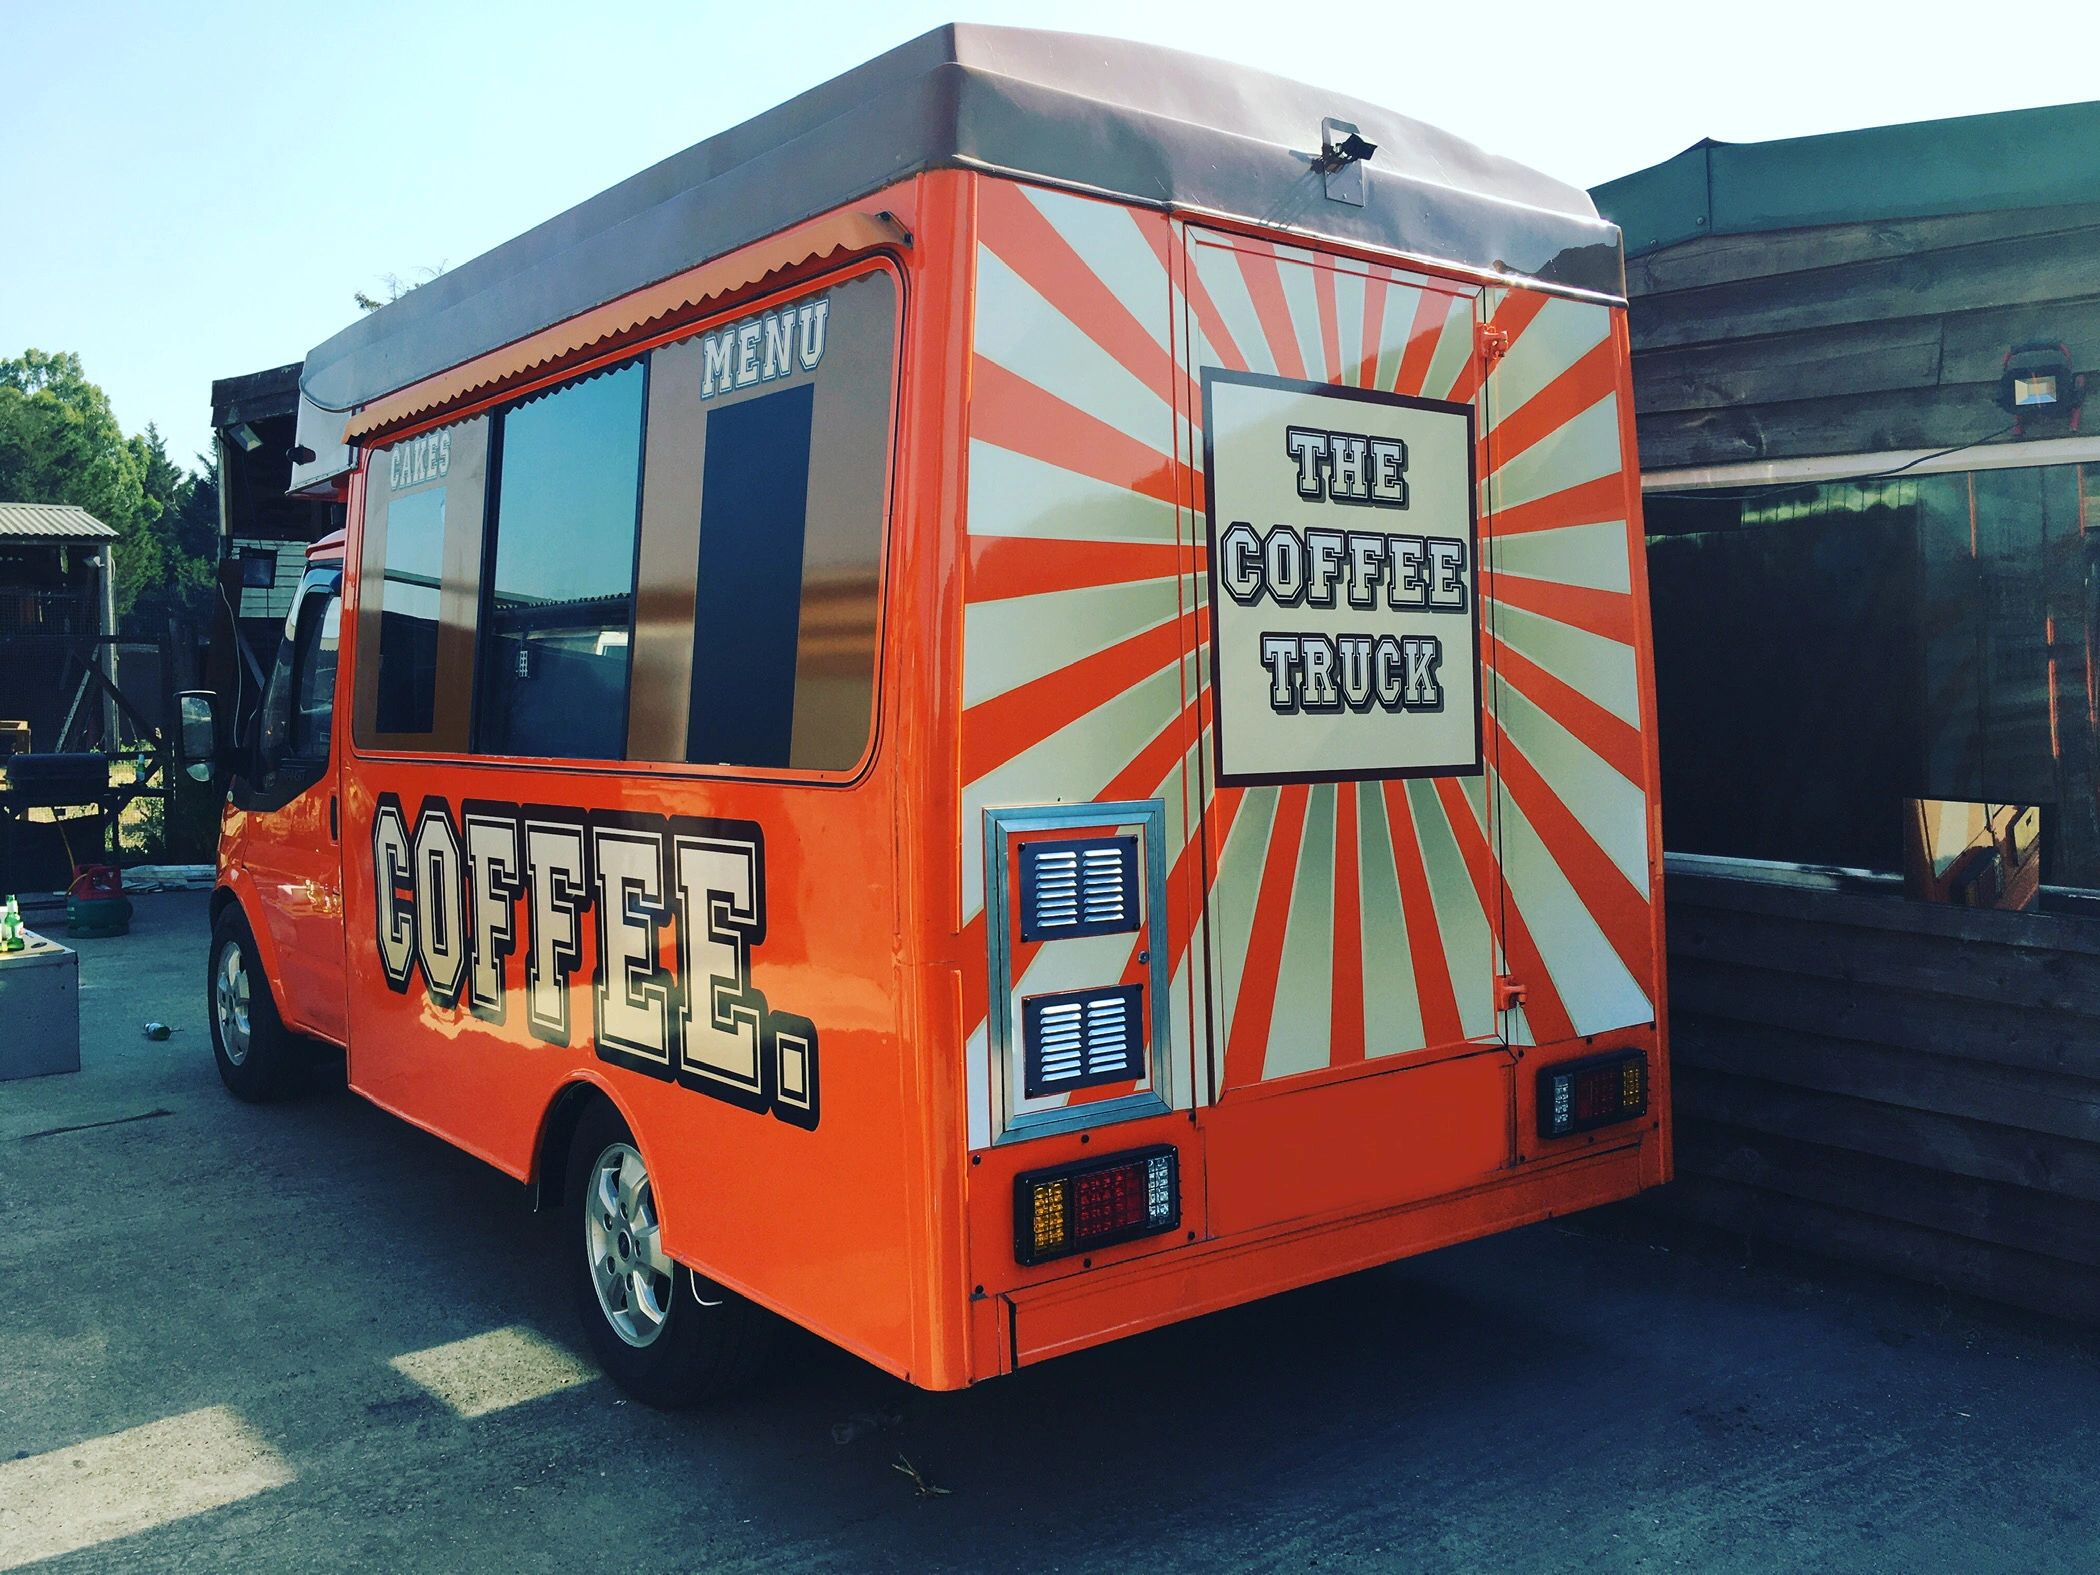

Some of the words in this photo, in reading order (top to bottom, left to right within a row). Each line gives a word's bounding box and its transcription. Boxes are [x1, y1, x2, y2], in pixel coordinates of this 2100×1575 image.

[702, 299, 829, 399] MENU
[390, 429, 452, 491] CAKES
[1286, 425, 1409, 510] THE
[1220, 521, 1468, 614] COFFEE
[1260, 632, 1445, 714] TRUCK
[372, 792, 820, 1132] COFFEE.
